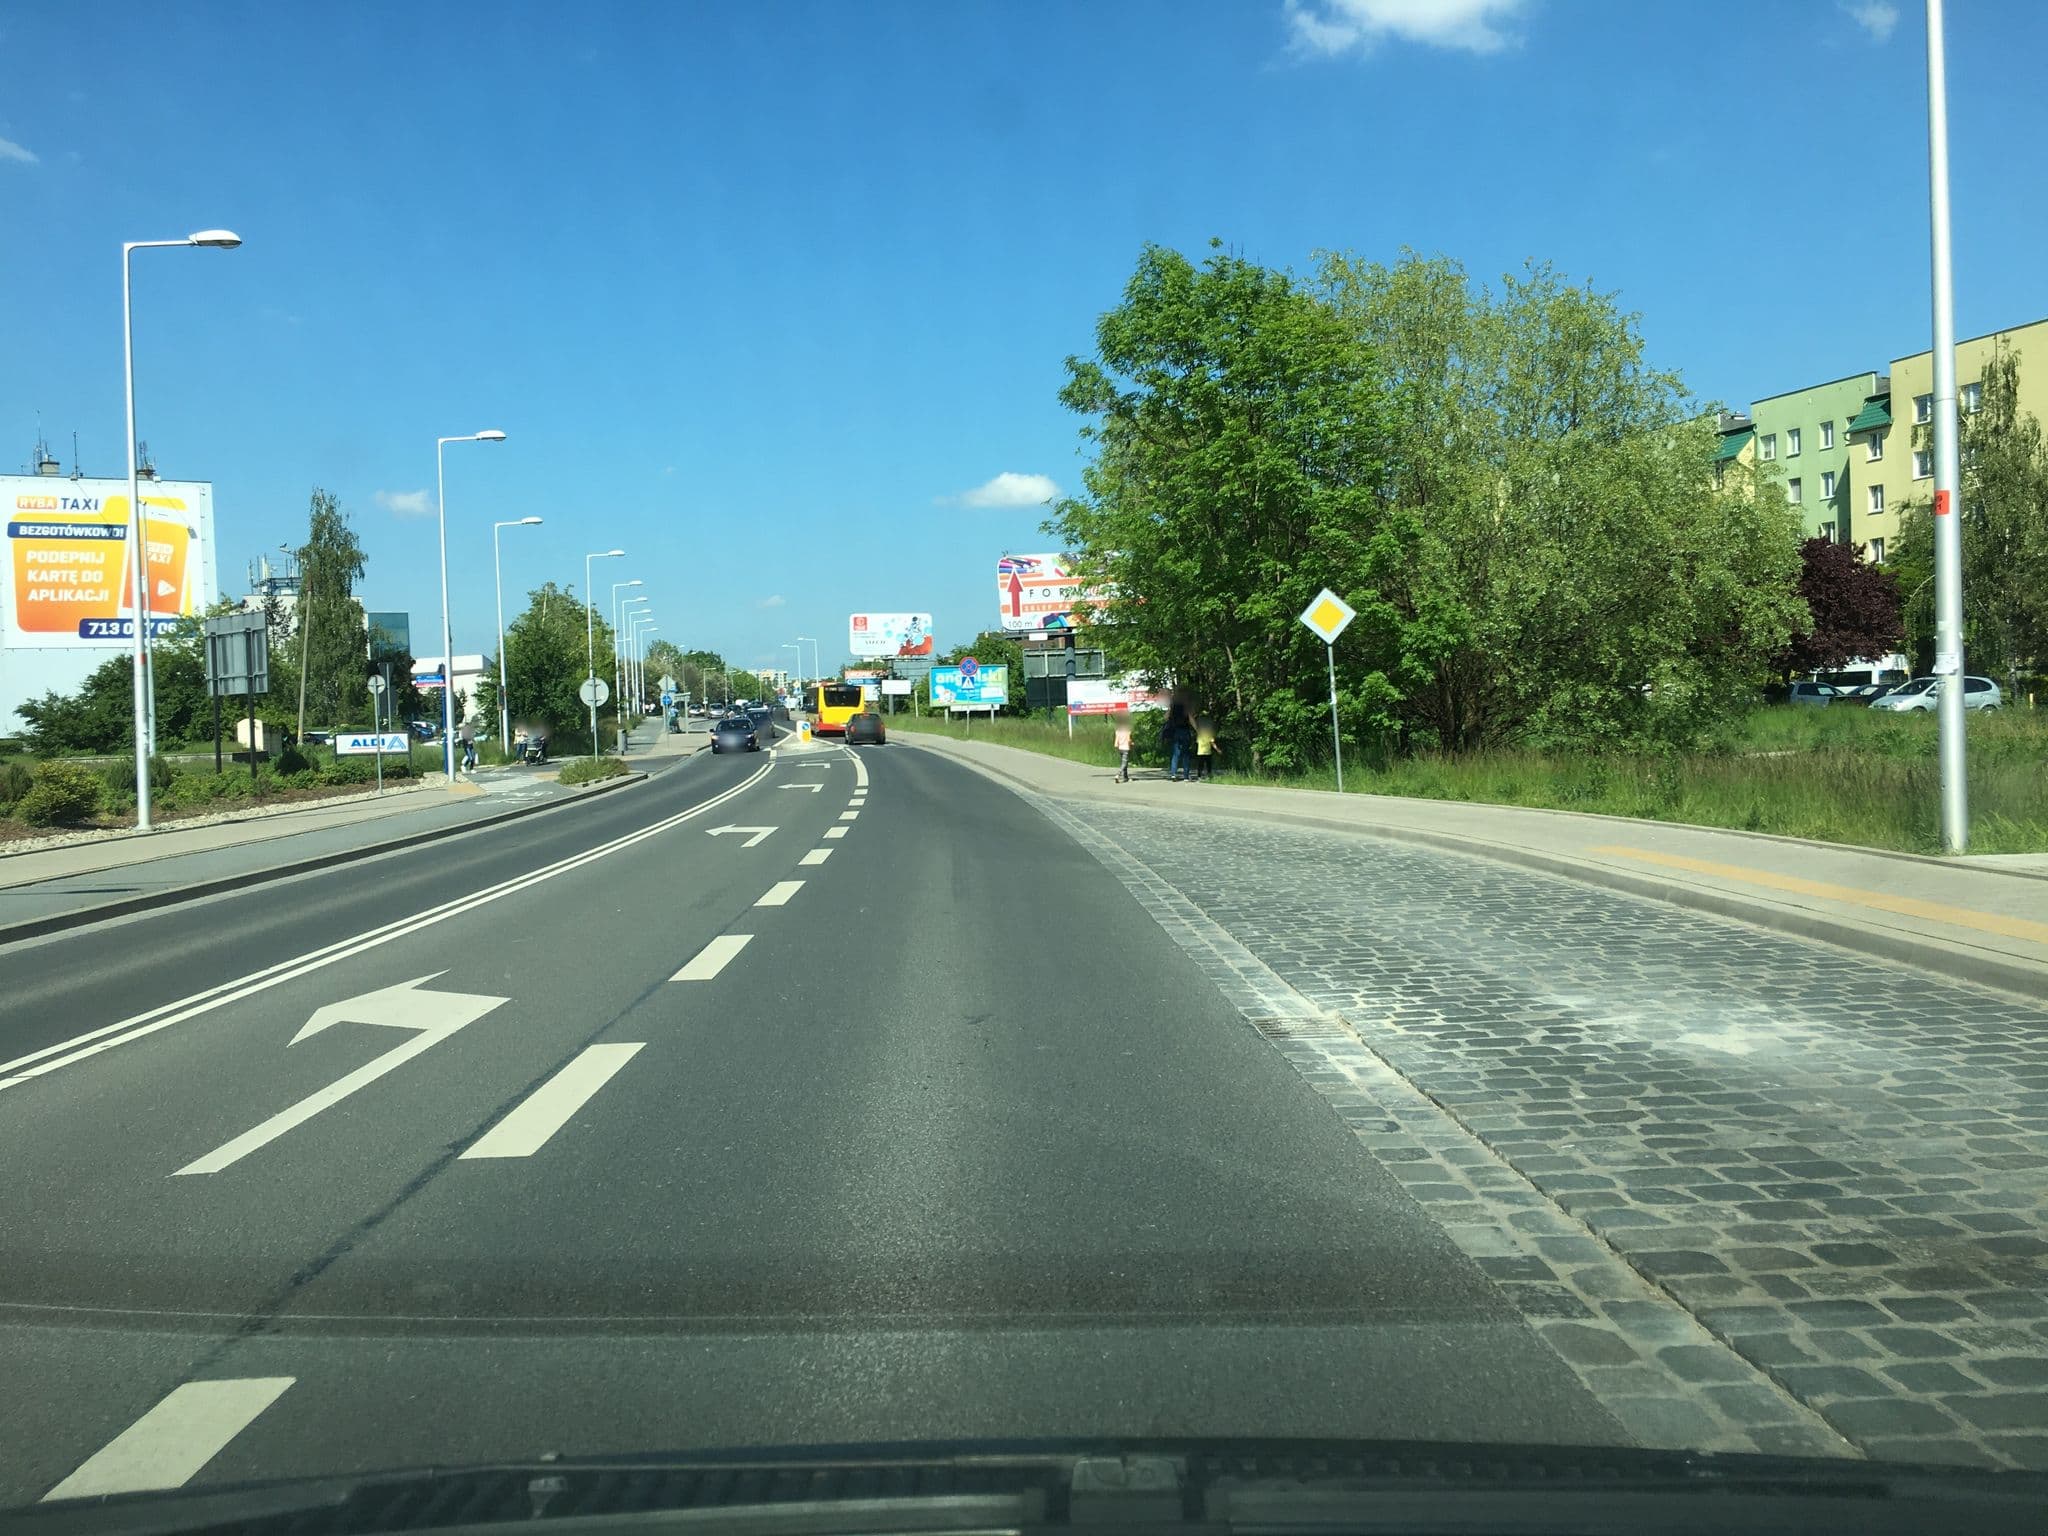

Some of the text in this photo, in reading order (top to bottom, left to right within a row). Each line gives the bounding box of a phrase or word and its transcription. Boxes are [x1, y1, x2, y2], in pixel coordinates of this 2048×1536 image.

[18, 496, 99, 510] RYBA TAXI
[19, 525, 124, 538] BEZGOTÓWKOWO!
[26, 550, 105, 565] PODEPNIJ
[27, 570, 103, 585] KARTĘ DO
[28, 588, 110, 602] APLIKACJI
[88, 622, 120, 635] 713
[351, 738, 386, 747] ALDI
